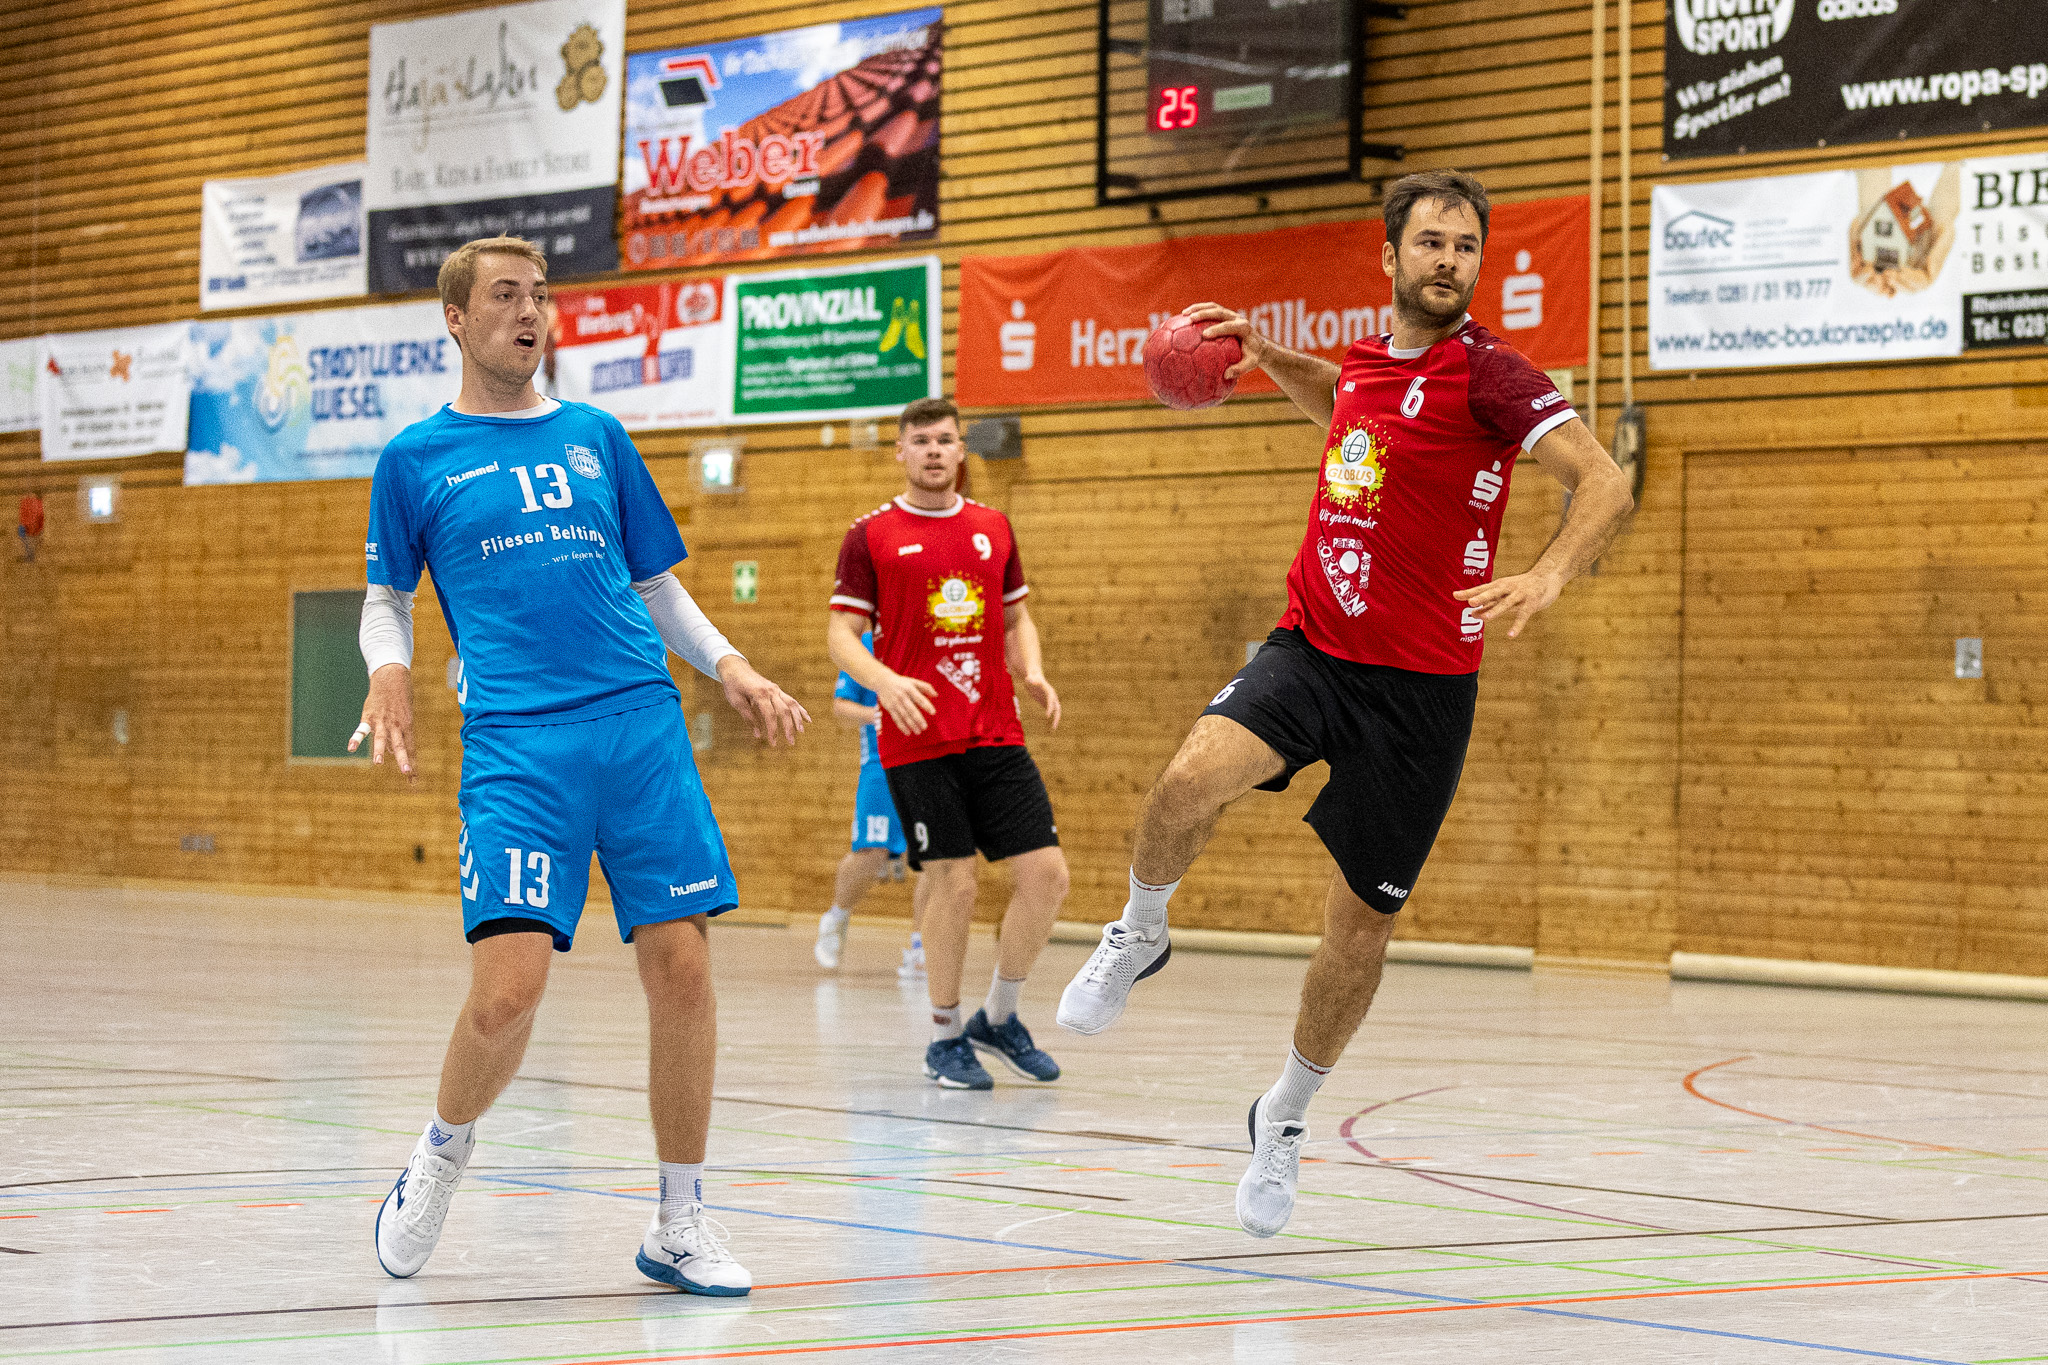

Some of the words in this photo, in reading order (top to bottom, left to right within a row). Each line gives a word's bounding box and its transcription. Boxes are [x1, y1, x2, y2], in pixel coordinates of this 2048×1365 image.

[1694, 14, 1773, 55] SPORT
[1676, 80, 1717, 110] Wir
[1718, 55, 1784, 96] ziehen
[1156, 85, 1199, 130] 25
[1673, 93, 1756, 140] Sportler
[1757, 73, 1791, 107] an!
[637, 127, 825, 196] Weber
[1664, 224, 1734, 251] bautec
[1972, 221, 2048, 245] Tis
[1807, 277, 1832, 299] 777
[742, 286, 883, 331] PROVINZIAL
[1237, 299, 1393, 350] illkom
[308, 338, 447, 382] STADTWERKE
[311, 384, 386, 420] WESEL
[1400, 376, 1428, 419] 6
[446, 461, 500, 487] hummel
[509, 463, 574, 513] 13
[1327, 467, 1372, 483] GLOBUS
[1352, 516, 1378, 529] mehr
[481, 531, 544, 556] Fliesen
[550, 525, 606, 548] Belting
[552, 552, 569, 564] wir
[571, 550, 594, 562] legen
[972, 533, 992, 560] 9
[1359, 551, 1372, 589] ANSGAR
[1209, 678, 1244, 706] 6
[914, 822, 929, 852] 9
[504, 847, 550, 908] 13
[669, 875, 718, 897] hummel
[1378, 881, 1408, 899] JAKO
